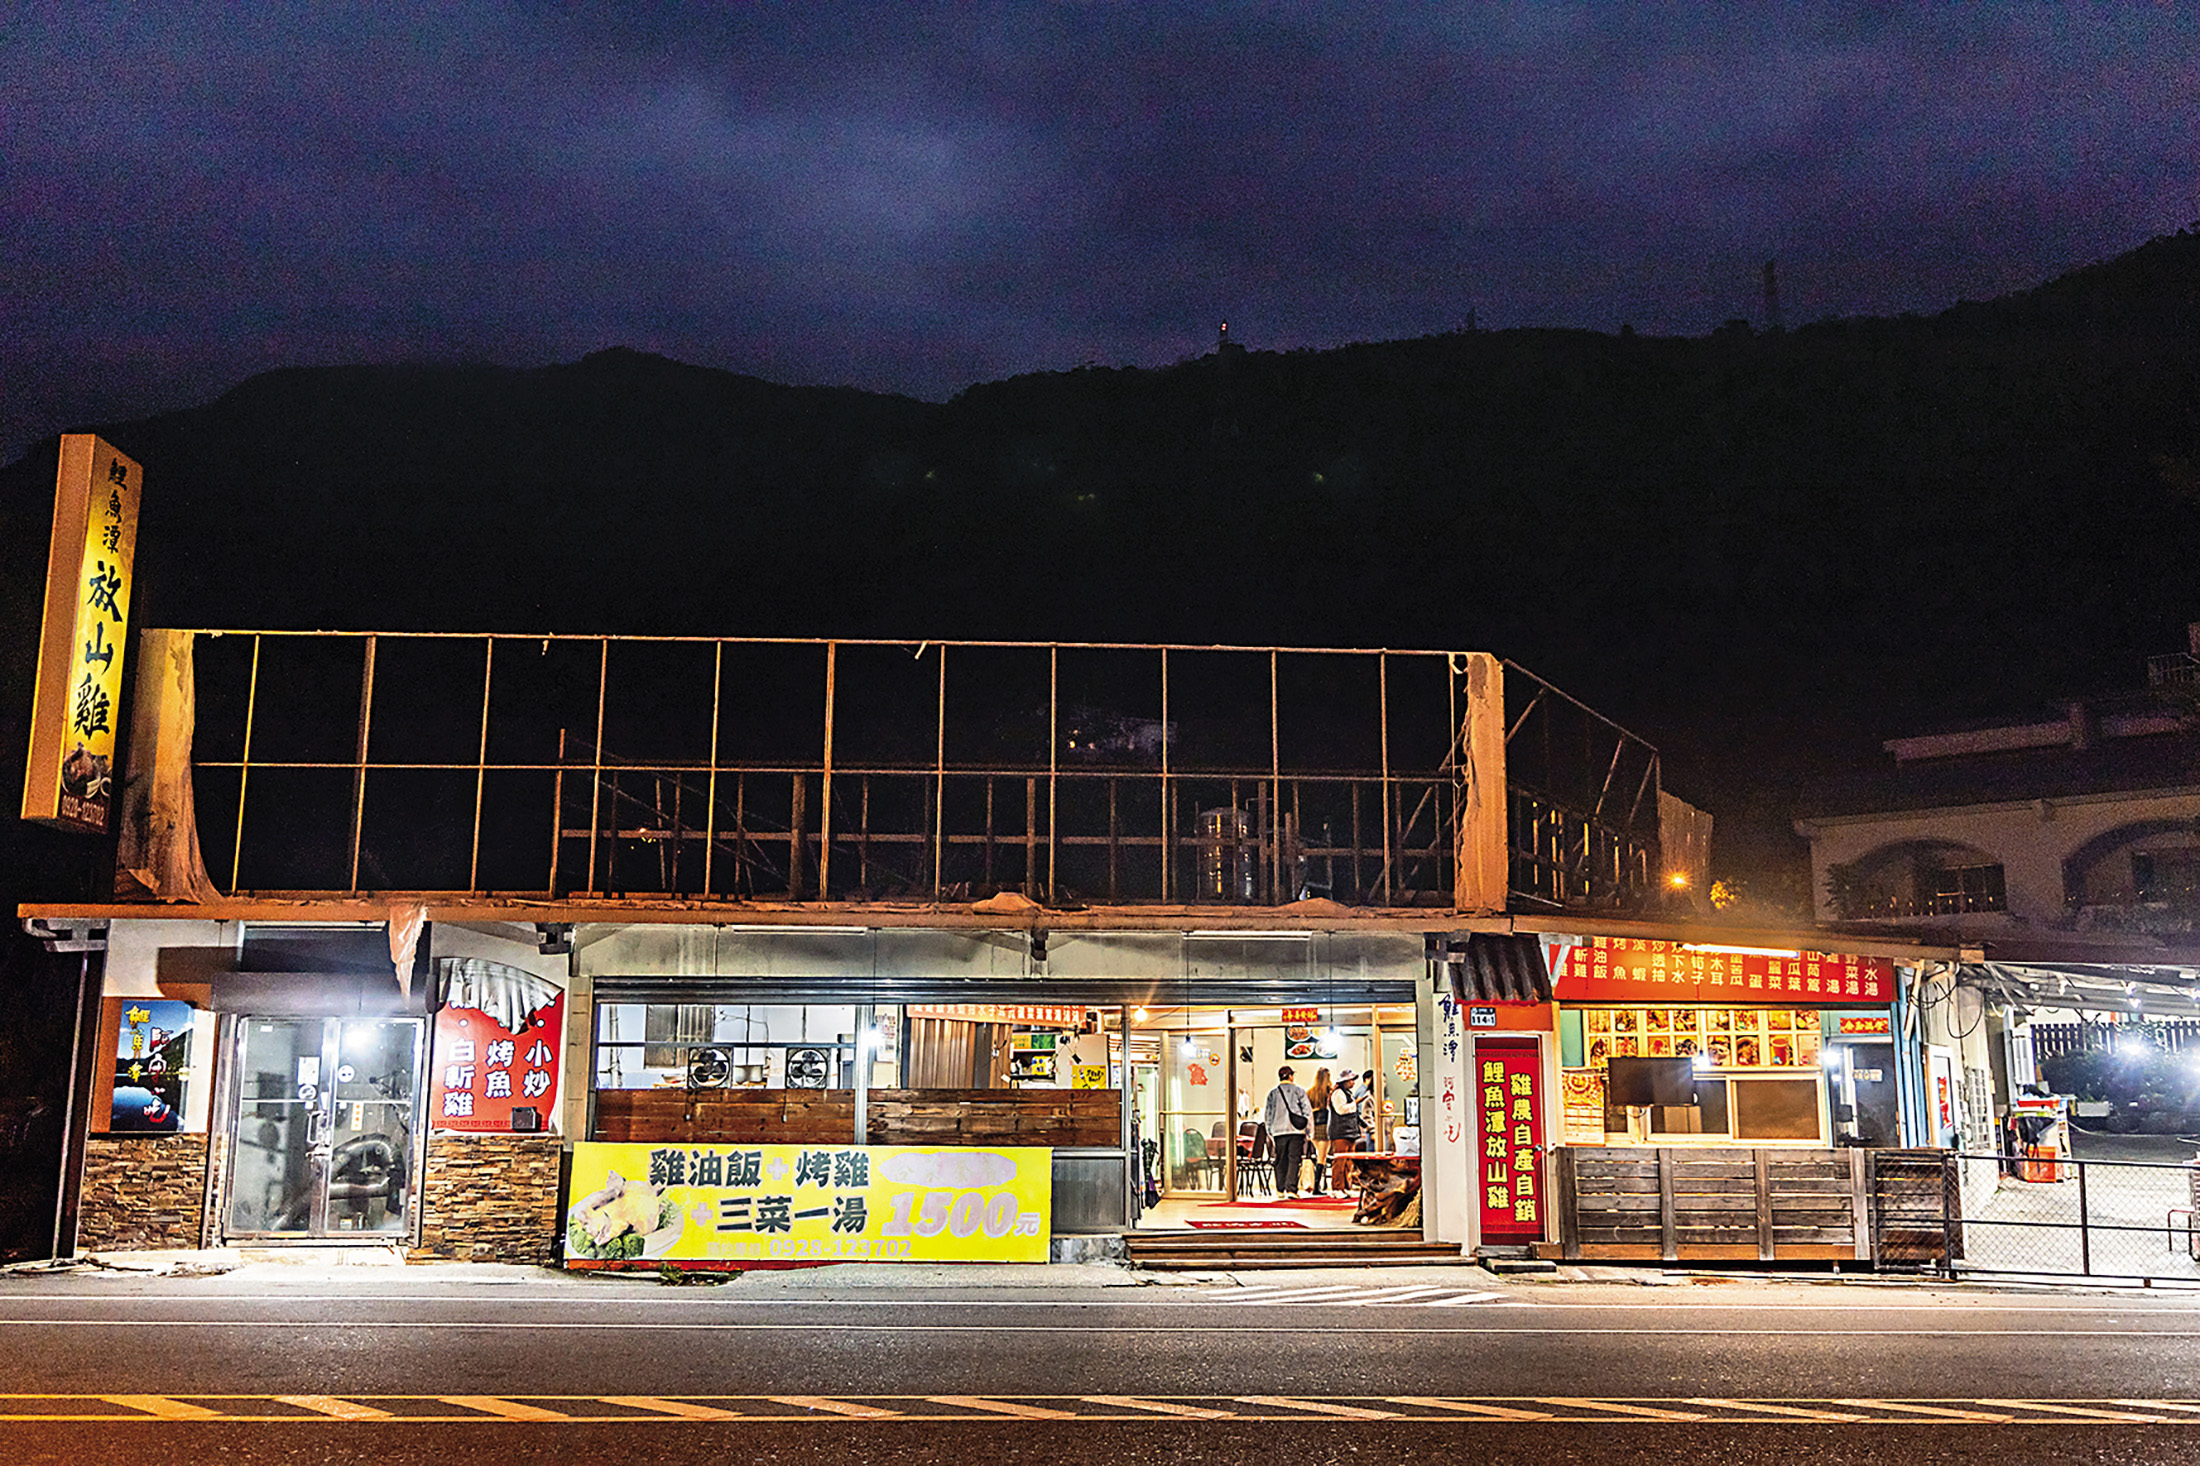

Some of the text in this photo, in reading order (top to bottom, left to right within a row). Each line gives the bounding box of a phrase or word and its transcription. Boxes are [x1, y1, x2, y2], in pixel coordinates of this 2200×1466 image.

[1709, 951, 1724, 986] 木耳
[443, 1038, 475, 1117] 白斬雞
[485, 1039, 515, 1098] 烤魚
[523, 1039, 552, 1098] 小炒
[1482, 1060, 1510, 1209] 鯉魚潭放山雞
[1510, 1073, 1537, 1222] 雞農自產自銷
[769, 1239, 912, 1257] 0928-123702
